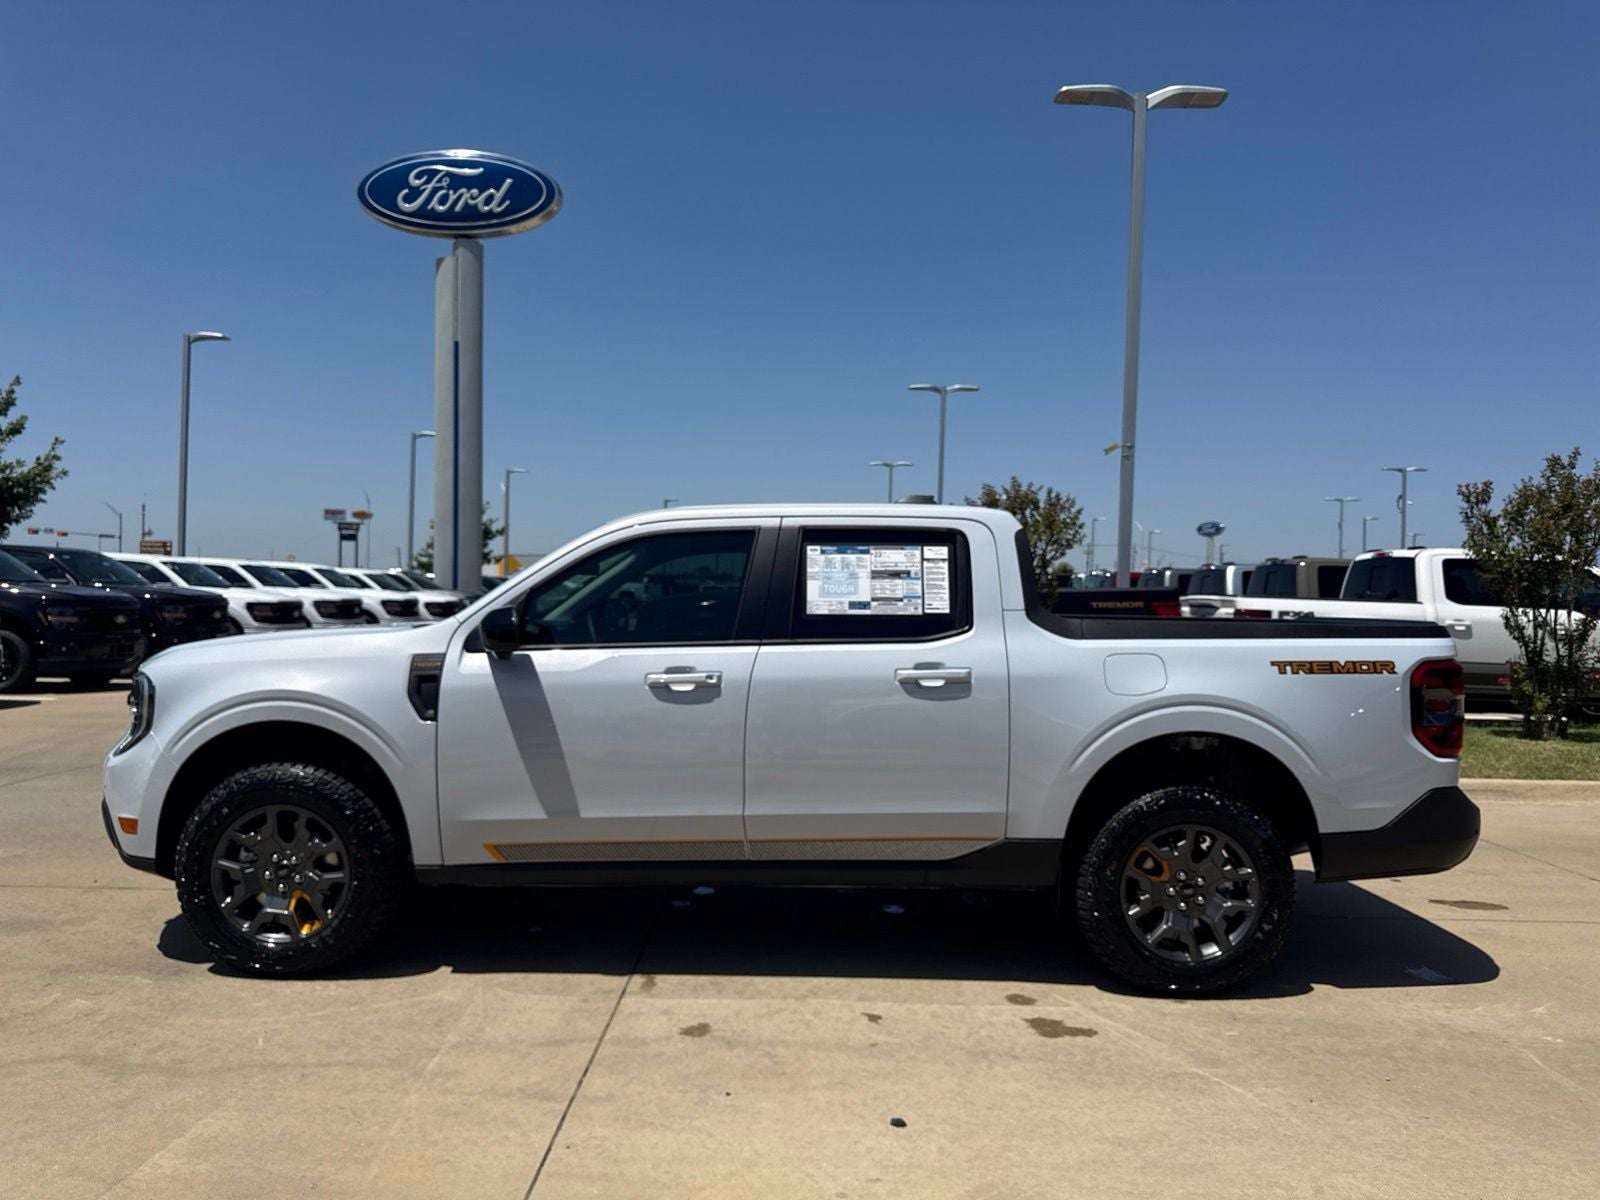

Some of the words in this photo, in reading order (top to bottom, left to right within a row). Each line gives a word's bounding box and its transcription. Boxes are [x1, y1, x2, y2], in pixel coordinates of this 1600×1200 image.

[396, 164, 514, 214] Ford
[823, 584, 855, 594] TOUGH
[1089, 601, 1145, 609] TREMOR
[1270, 660, 1398, 675] TREMOR
